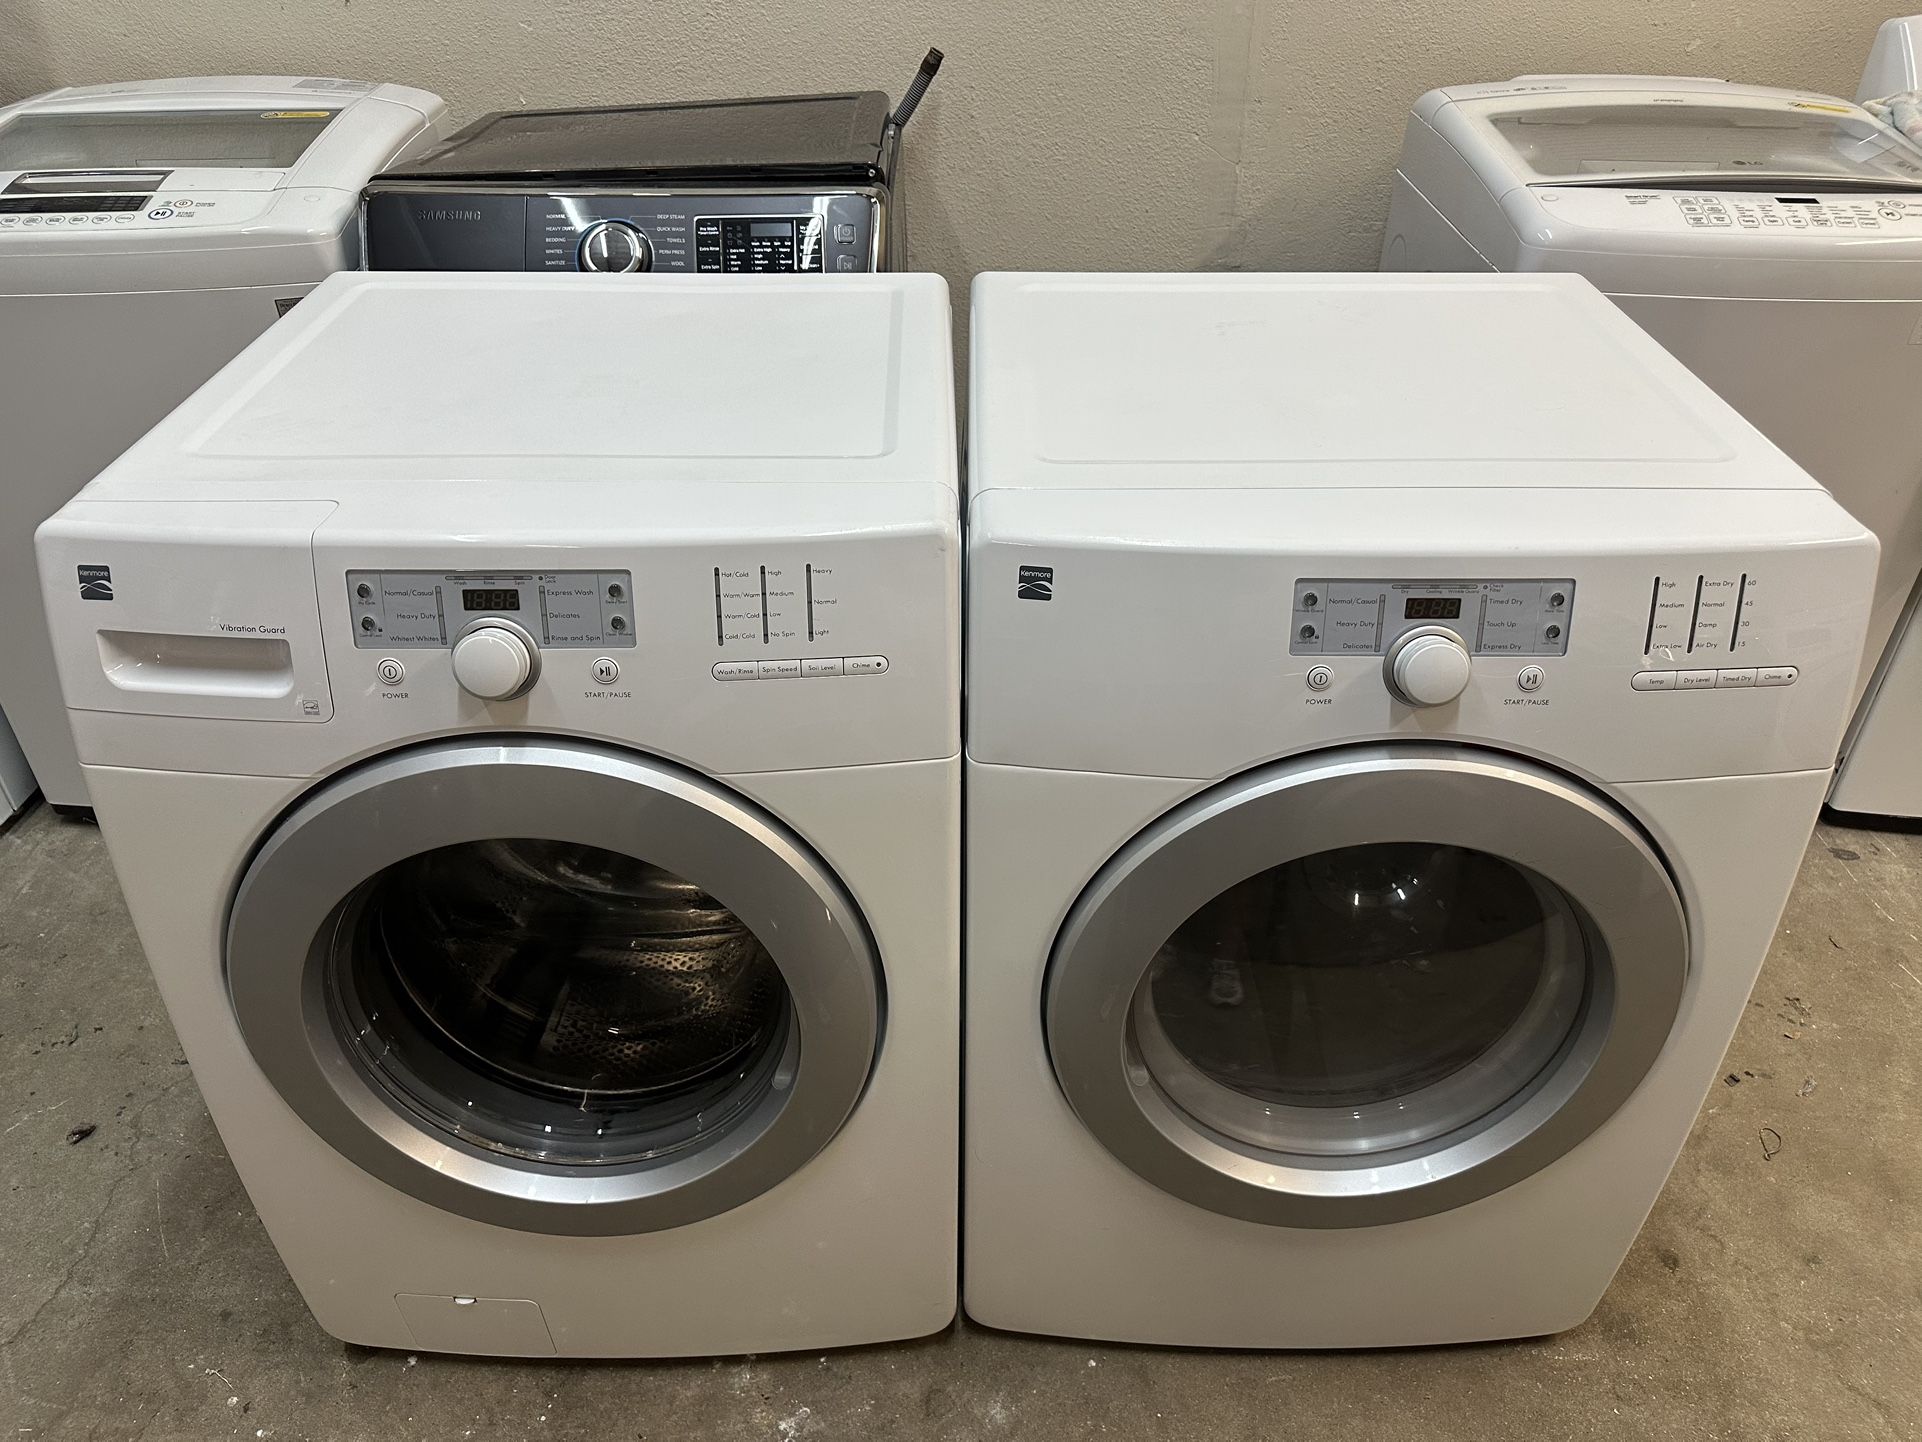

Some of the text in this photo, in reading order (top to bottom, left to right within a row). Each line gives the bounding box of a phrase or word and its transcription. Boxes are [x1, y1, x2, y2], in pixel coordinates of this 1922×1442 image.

[417, 210, 481, 221] SAMSUNG
[78, 568, 109, 578] Kenmore
[721, 570, 749, 578] Hot/Cold
[767, 569, 782, 577] High
[1020, 570, 1052, 579] Kenmore
[1661, 581, 1676, 589] High
[1722, 580, 1734, 588] Dry
[384, 589, 434, 597] Normal/Casual
[546, 589, 573, 597] Express
[1511, 598, 1523, 606] Dry
[396, 612, 436, 620] Heavy Duty
[724, 612, 760, 620] Warm/Cold
[219, 623, 286, 634] Vibration Guard
[1359, 621, 1375, 629] Duty
[724, 633, 756, 641] Cold/Cold
[781, 631, 796, 639] Spin
[815, 629, 830, 637] Light
[585, 634, 601, 642] Spin
[1483, 643, 1521, 651] Express Dry
[1652, 642, 1669, 650] Extra
[716, 668, 754, 676] Wash/Rinse
[762, 666, 776, 674] Spin
[777, 665, 798, 674] Speed
[1649, 678, 1665, 686] Temp
[1740, 675, 1752, 683] Dry
[1764, 673, 1782, 681] Chime
[584, 691, 632, 699] START/PAUSE
[1503, 698, 1550, 707] START/PAUSE
